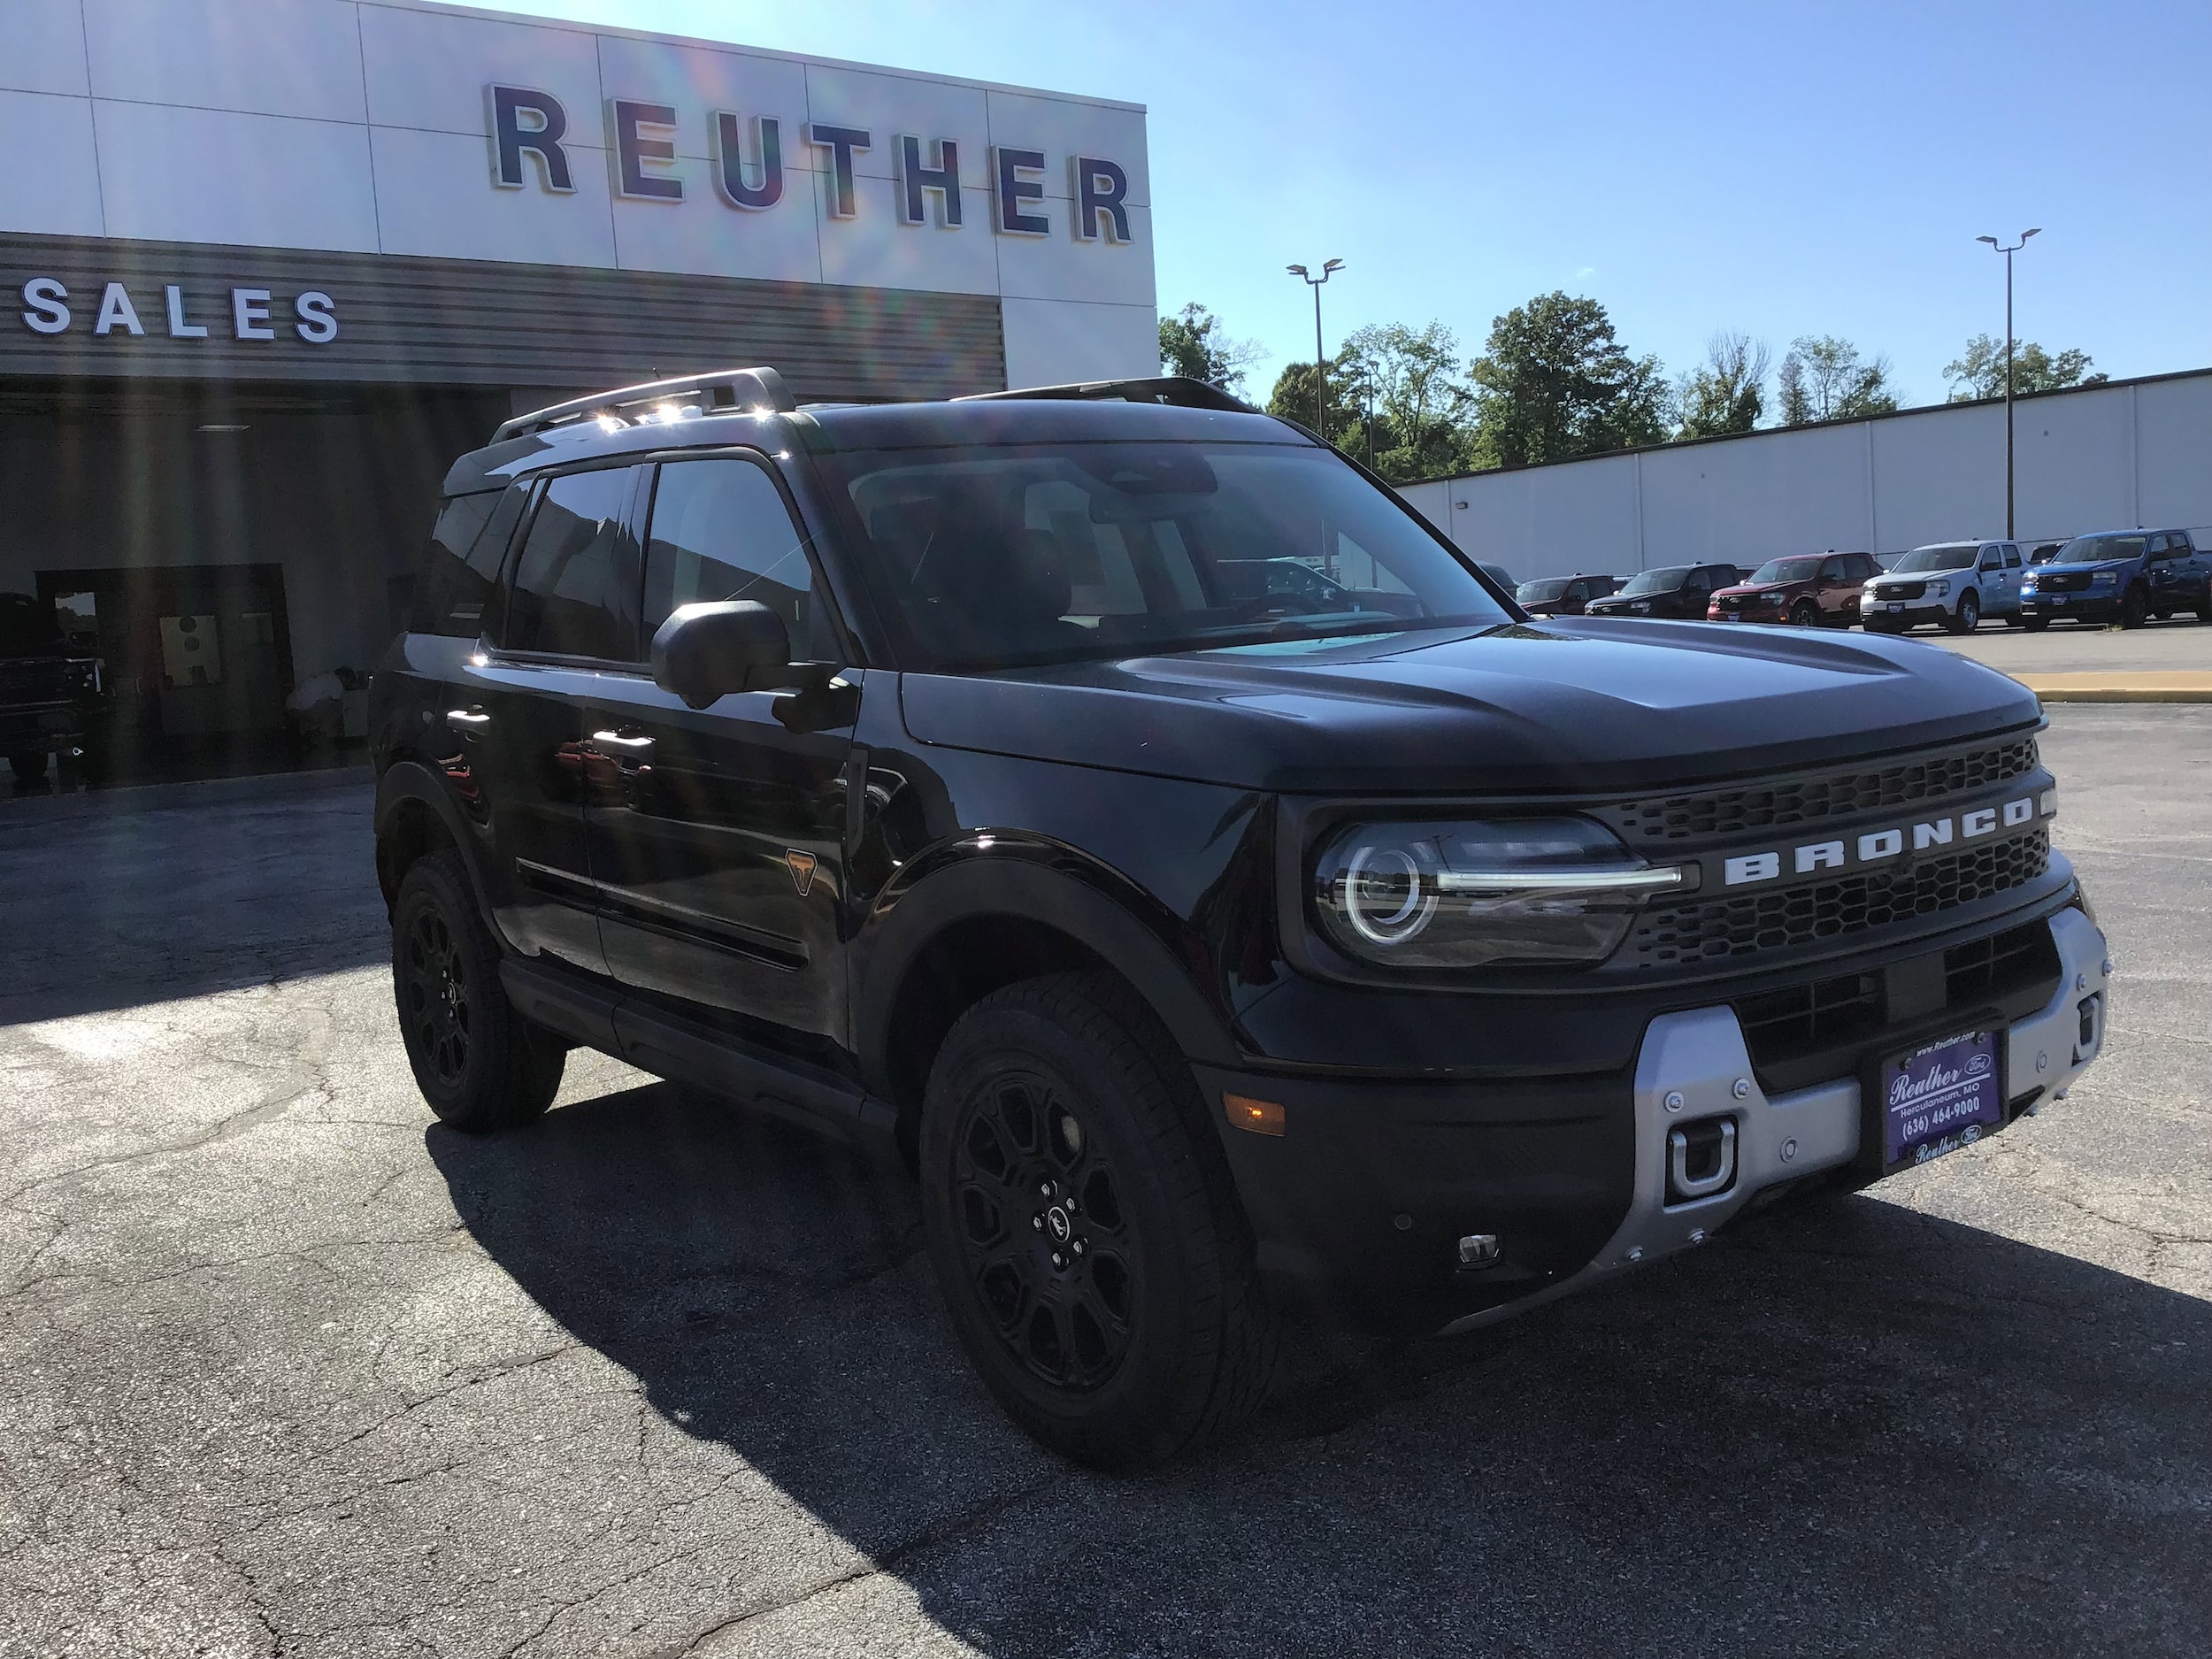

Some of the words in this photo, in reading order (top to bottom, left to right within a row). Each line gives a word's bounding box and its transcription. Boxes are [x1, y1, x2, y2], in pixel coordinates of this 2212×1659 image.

[488, 82, 1133, 244] REUTHER
[21, 277, 340, 343] SALES
[1724, 797, 2032, 885] BRONCO
[1916, 1031, 1976, 1056] www.Reuther.com
[1889, 1064, 1962, 1105] Reuther
[1967, 1056, 1988, 1073] Ford
[1901, 1090, 1962, 1118] Herculaneum,
[1963, 1083, 1980, 1094] MO
[1902, 1115, 1929, 1141] (636)
[1932, 1096, 1980, 1125] 464-9000
[1915, 1136, 1960, 1164] Reuther
